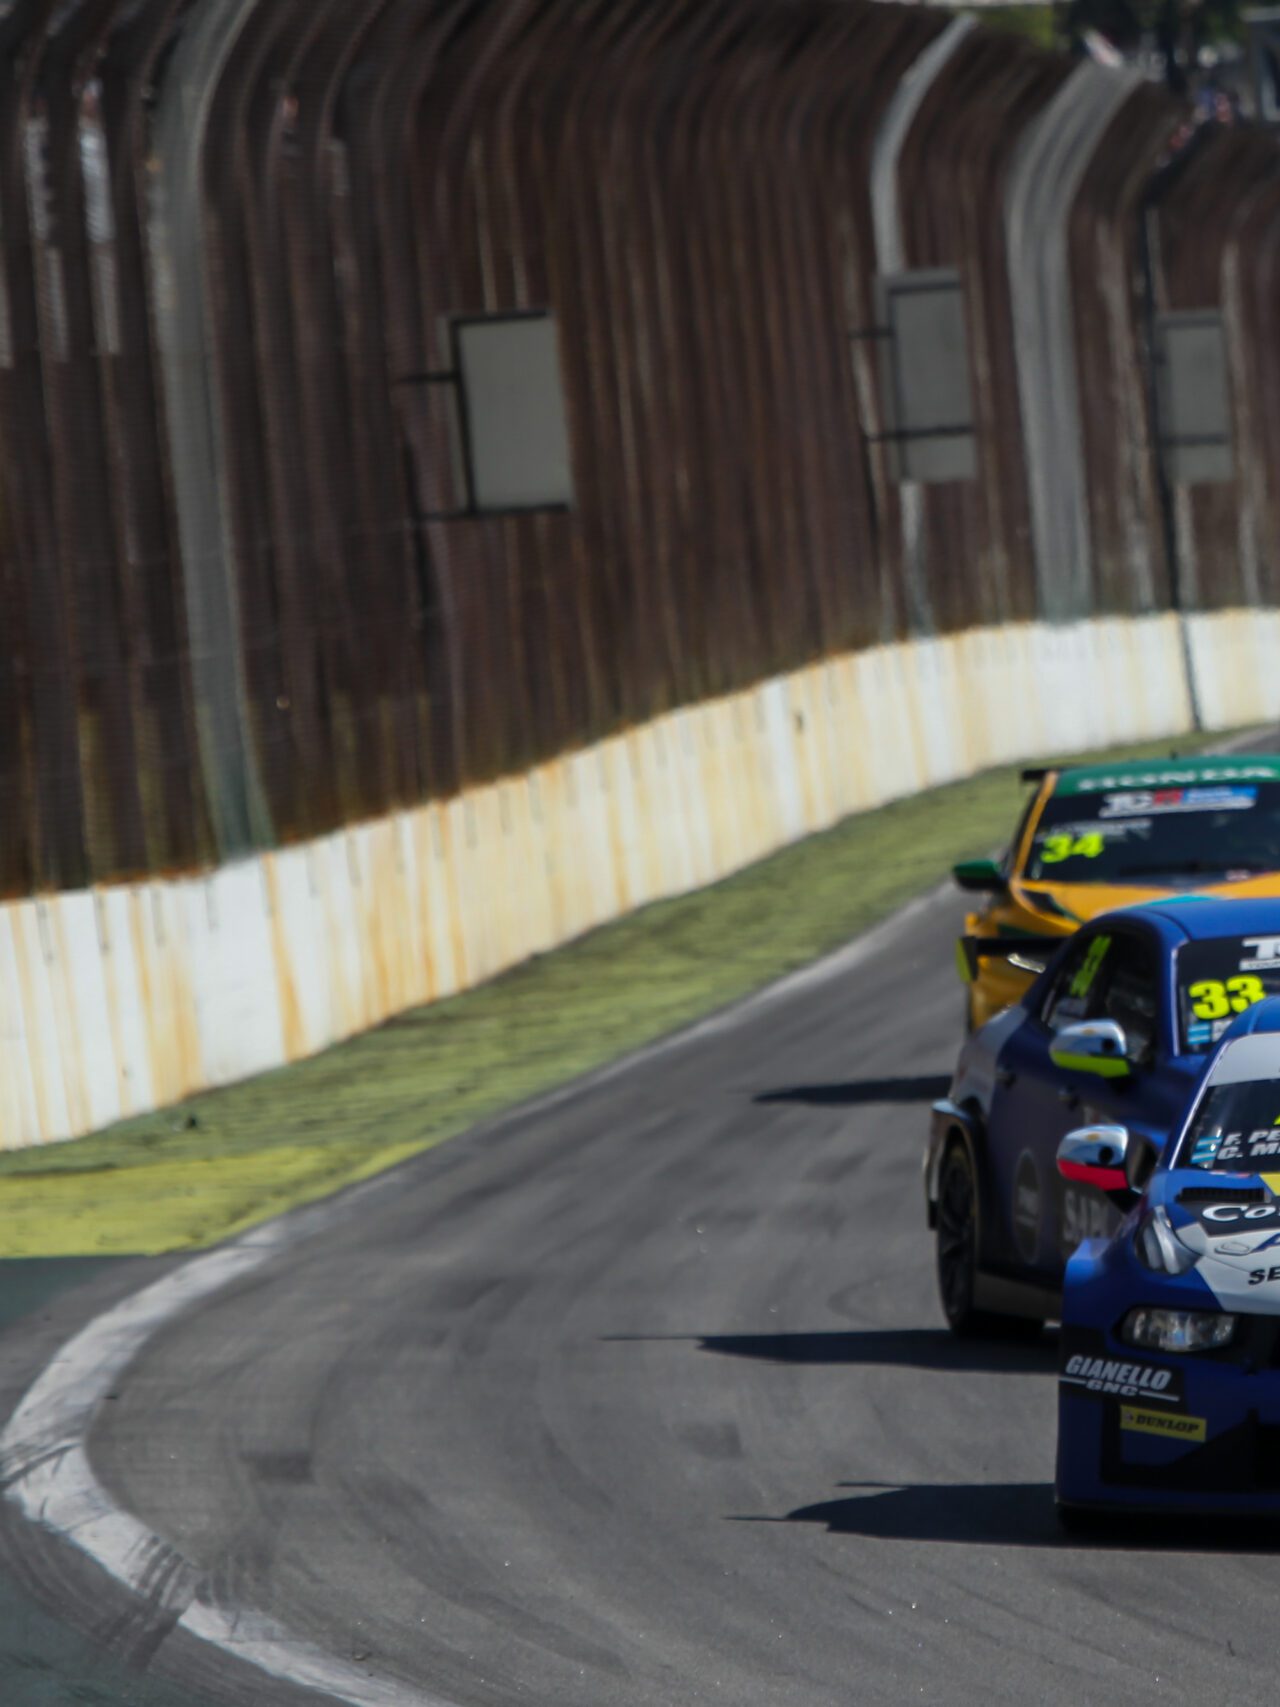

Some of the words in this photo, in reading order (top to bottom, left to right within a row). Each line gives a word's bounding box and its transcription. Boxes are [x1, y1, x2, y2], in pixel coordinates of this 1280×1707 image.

[1041, 832, 1104, 864] 34
[1189, 975, 1266, 1019] 33
[1223, 1132, 1242, 1147] F.
[1216, 1146, 1243, 1160] C.
[1065, 1355, 1172, 1391] GIANELLO
[1086, 1379, 1139, 1397] GNC
[1135, 1413, 1200, 1434] DUNLOP
